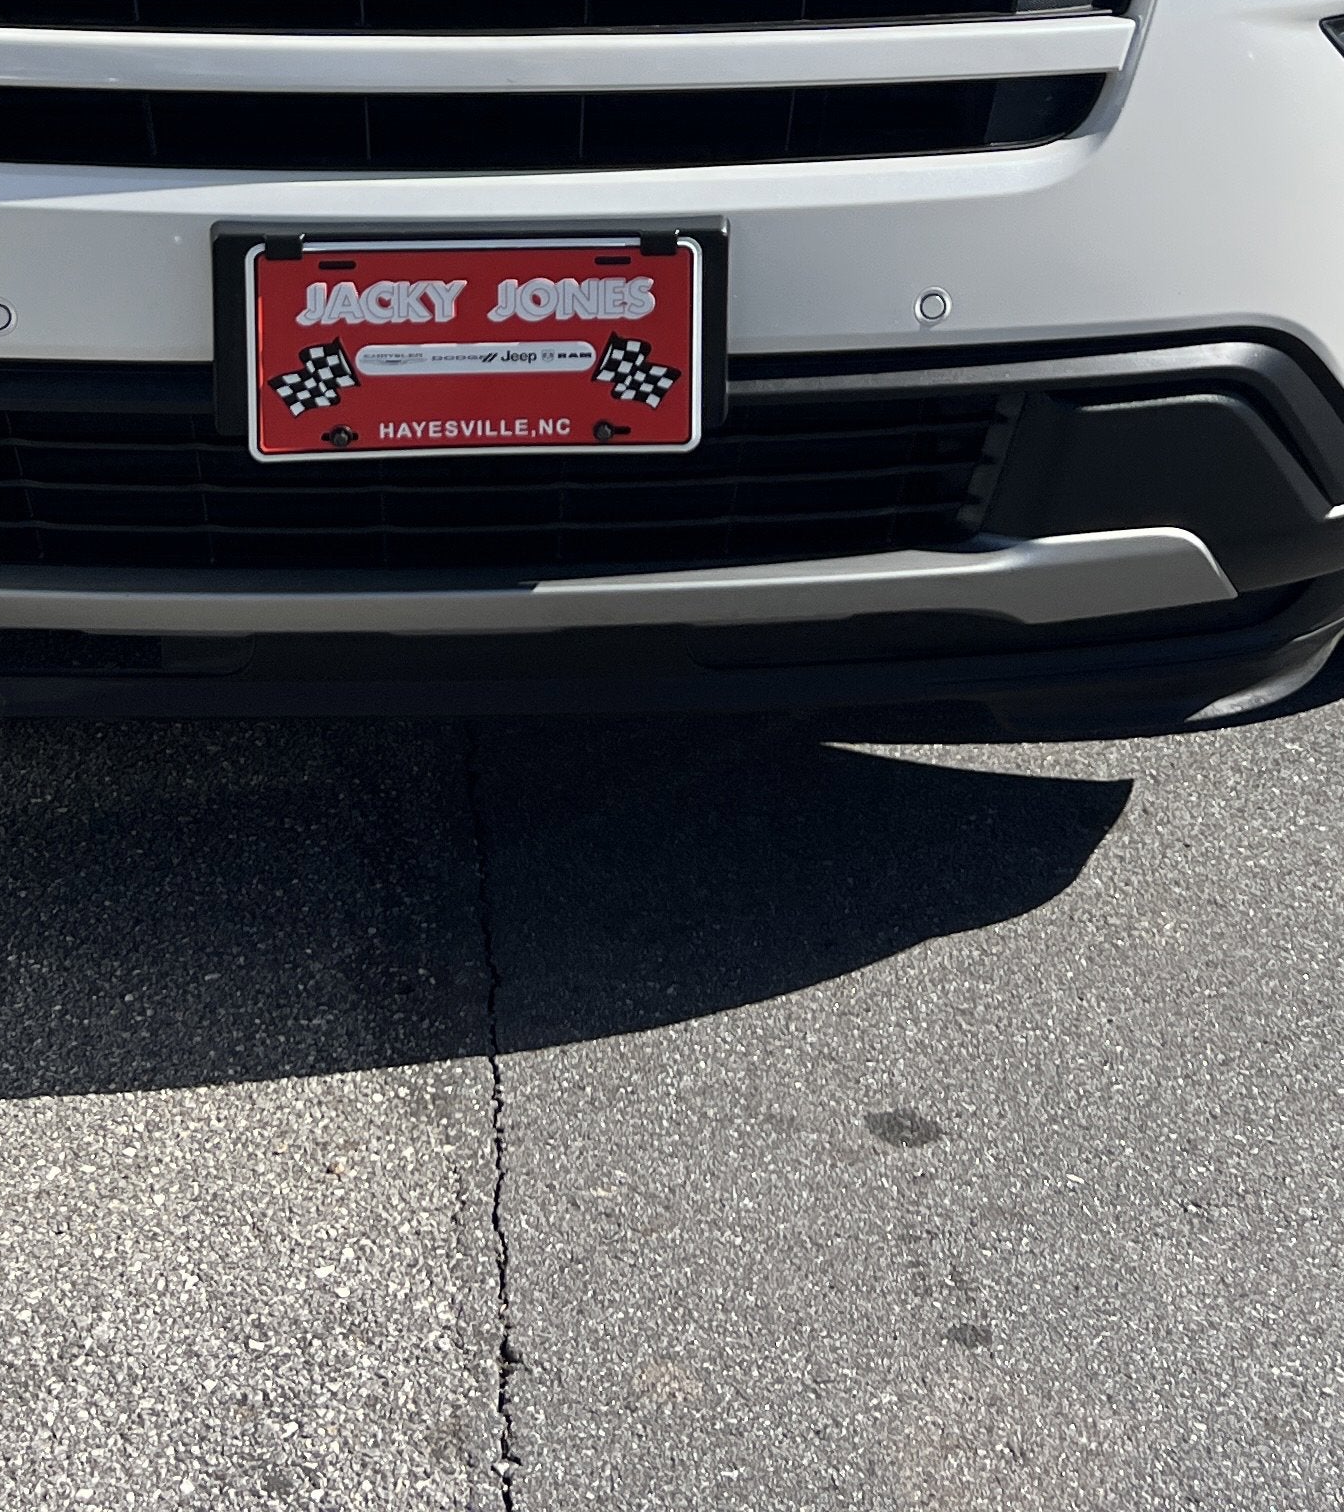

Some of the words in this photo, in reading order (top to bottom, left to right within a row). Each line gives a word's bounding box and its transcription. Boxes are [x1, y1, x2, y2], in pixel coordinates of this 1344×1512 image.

[296, 278, 467, 325] JACKY
[487, 276, 656, 323] JONES
[500, 350, 537, 363] Jeep
[557, 351, 592, 359] RAM
